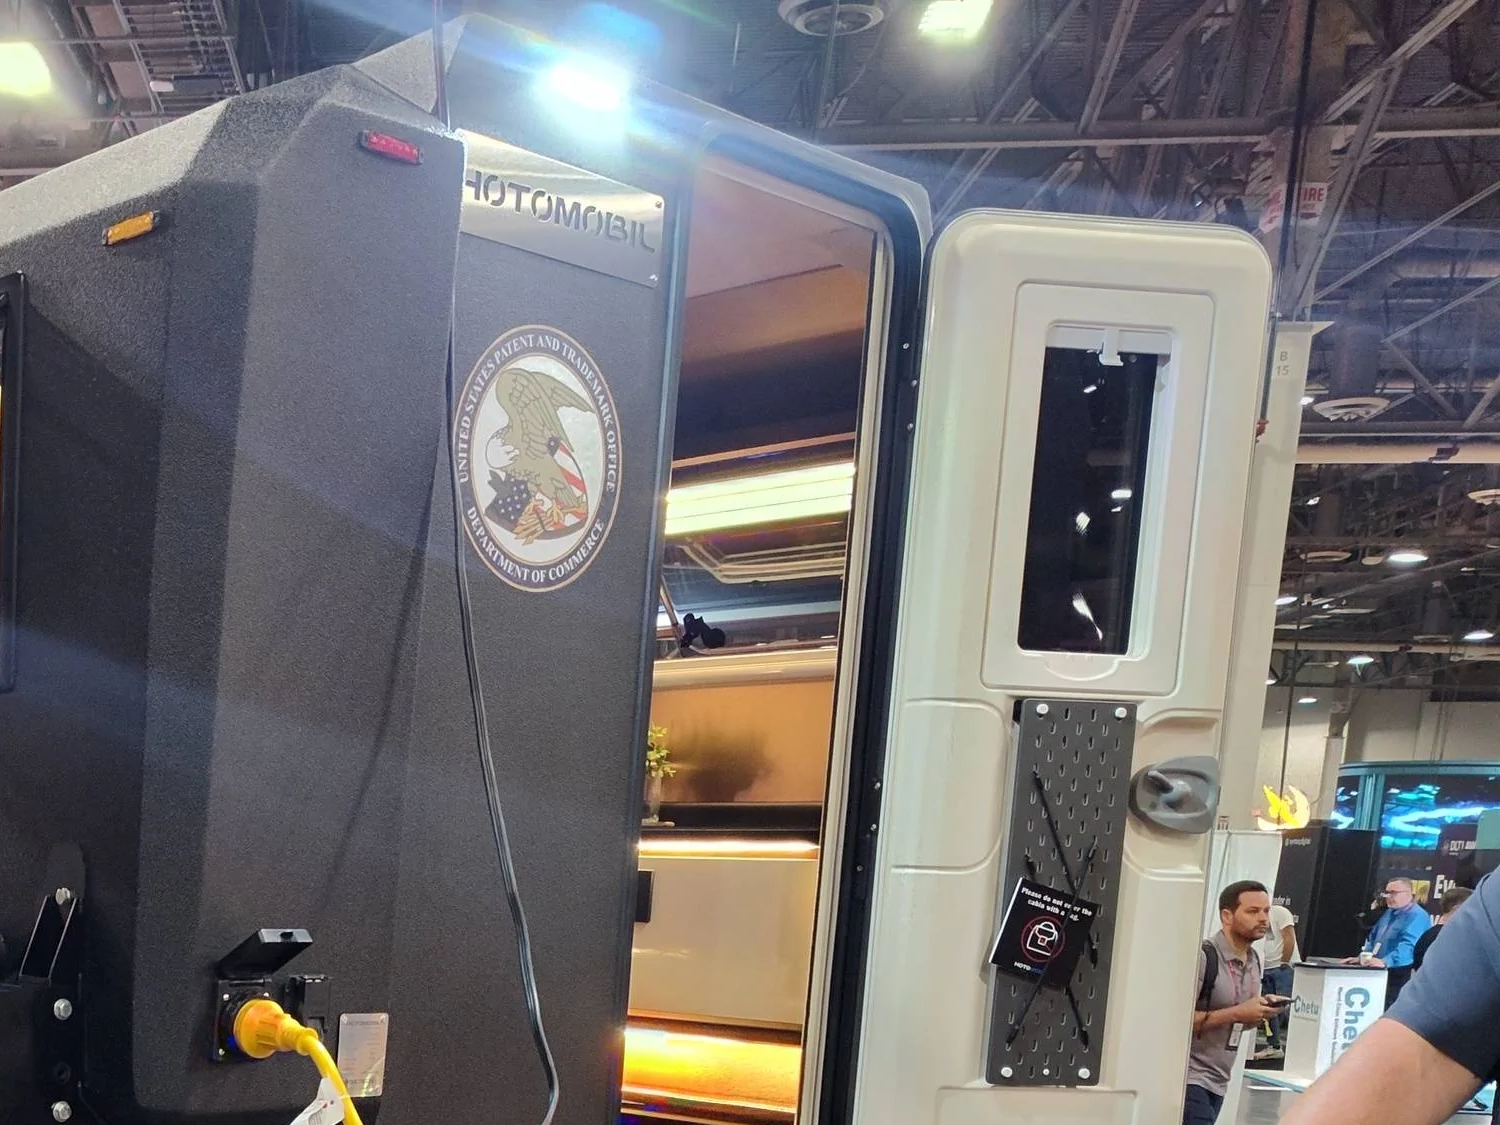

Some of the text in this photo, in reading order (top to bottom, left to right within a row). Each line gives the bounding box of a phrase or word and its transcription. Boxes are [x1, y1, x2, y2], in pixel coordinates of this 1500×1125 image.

[466, 170, 656, 254] HOTOMOBIL
[458, 334, 617, 493] UNITED STATES PATENT AND TRADEMARK OFFICE
[467, 506, 605, 583] DEPARTMENT OF COMMERCE
[1021, 887, 1042, 899] Please
[1052, 898, 1063, 907] not
[1081, 908, 1093, 916] the
[1027, 899, 1045, 910] cabin
[1046, 905, 1060, 914] with
[1294, 995, 1320, 1015] Chetu
